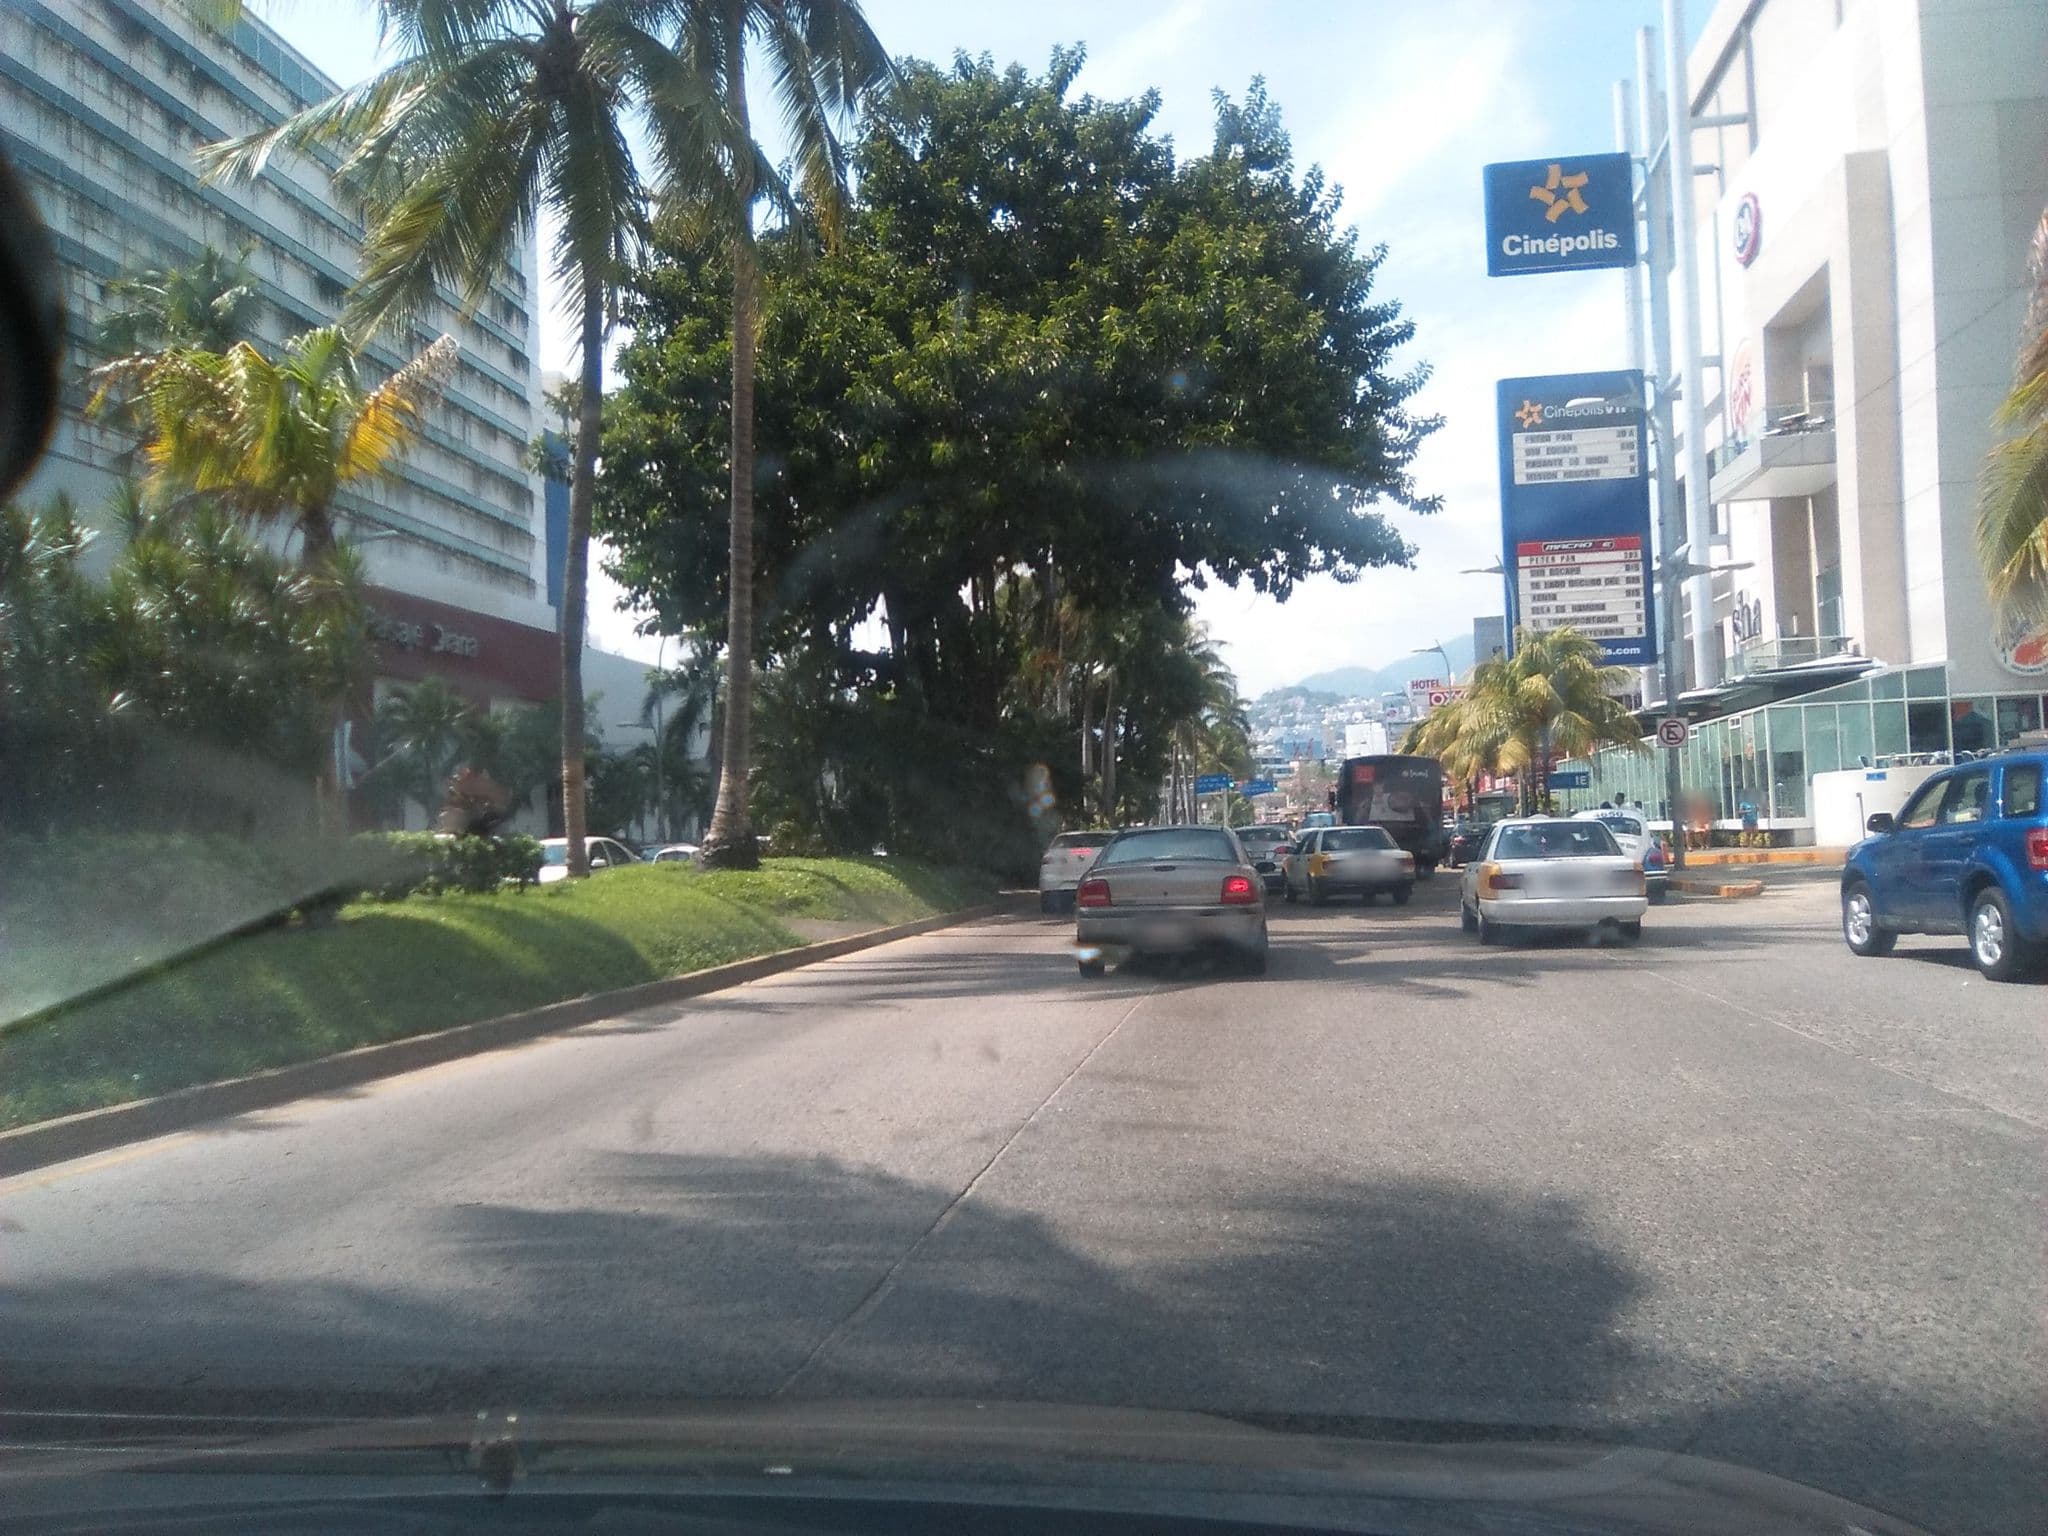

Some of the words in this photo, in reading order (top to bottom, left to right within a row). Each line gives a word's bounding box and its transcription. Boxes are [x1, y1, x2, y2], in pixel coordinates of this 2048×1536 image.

[1502, 228, 1618, 257] Cinépolis
[1529, 556, 1556, 565] PETER
[1560, 554, 1576, 564] PAN
[1411, 679, 1440, 690] HOTEL
